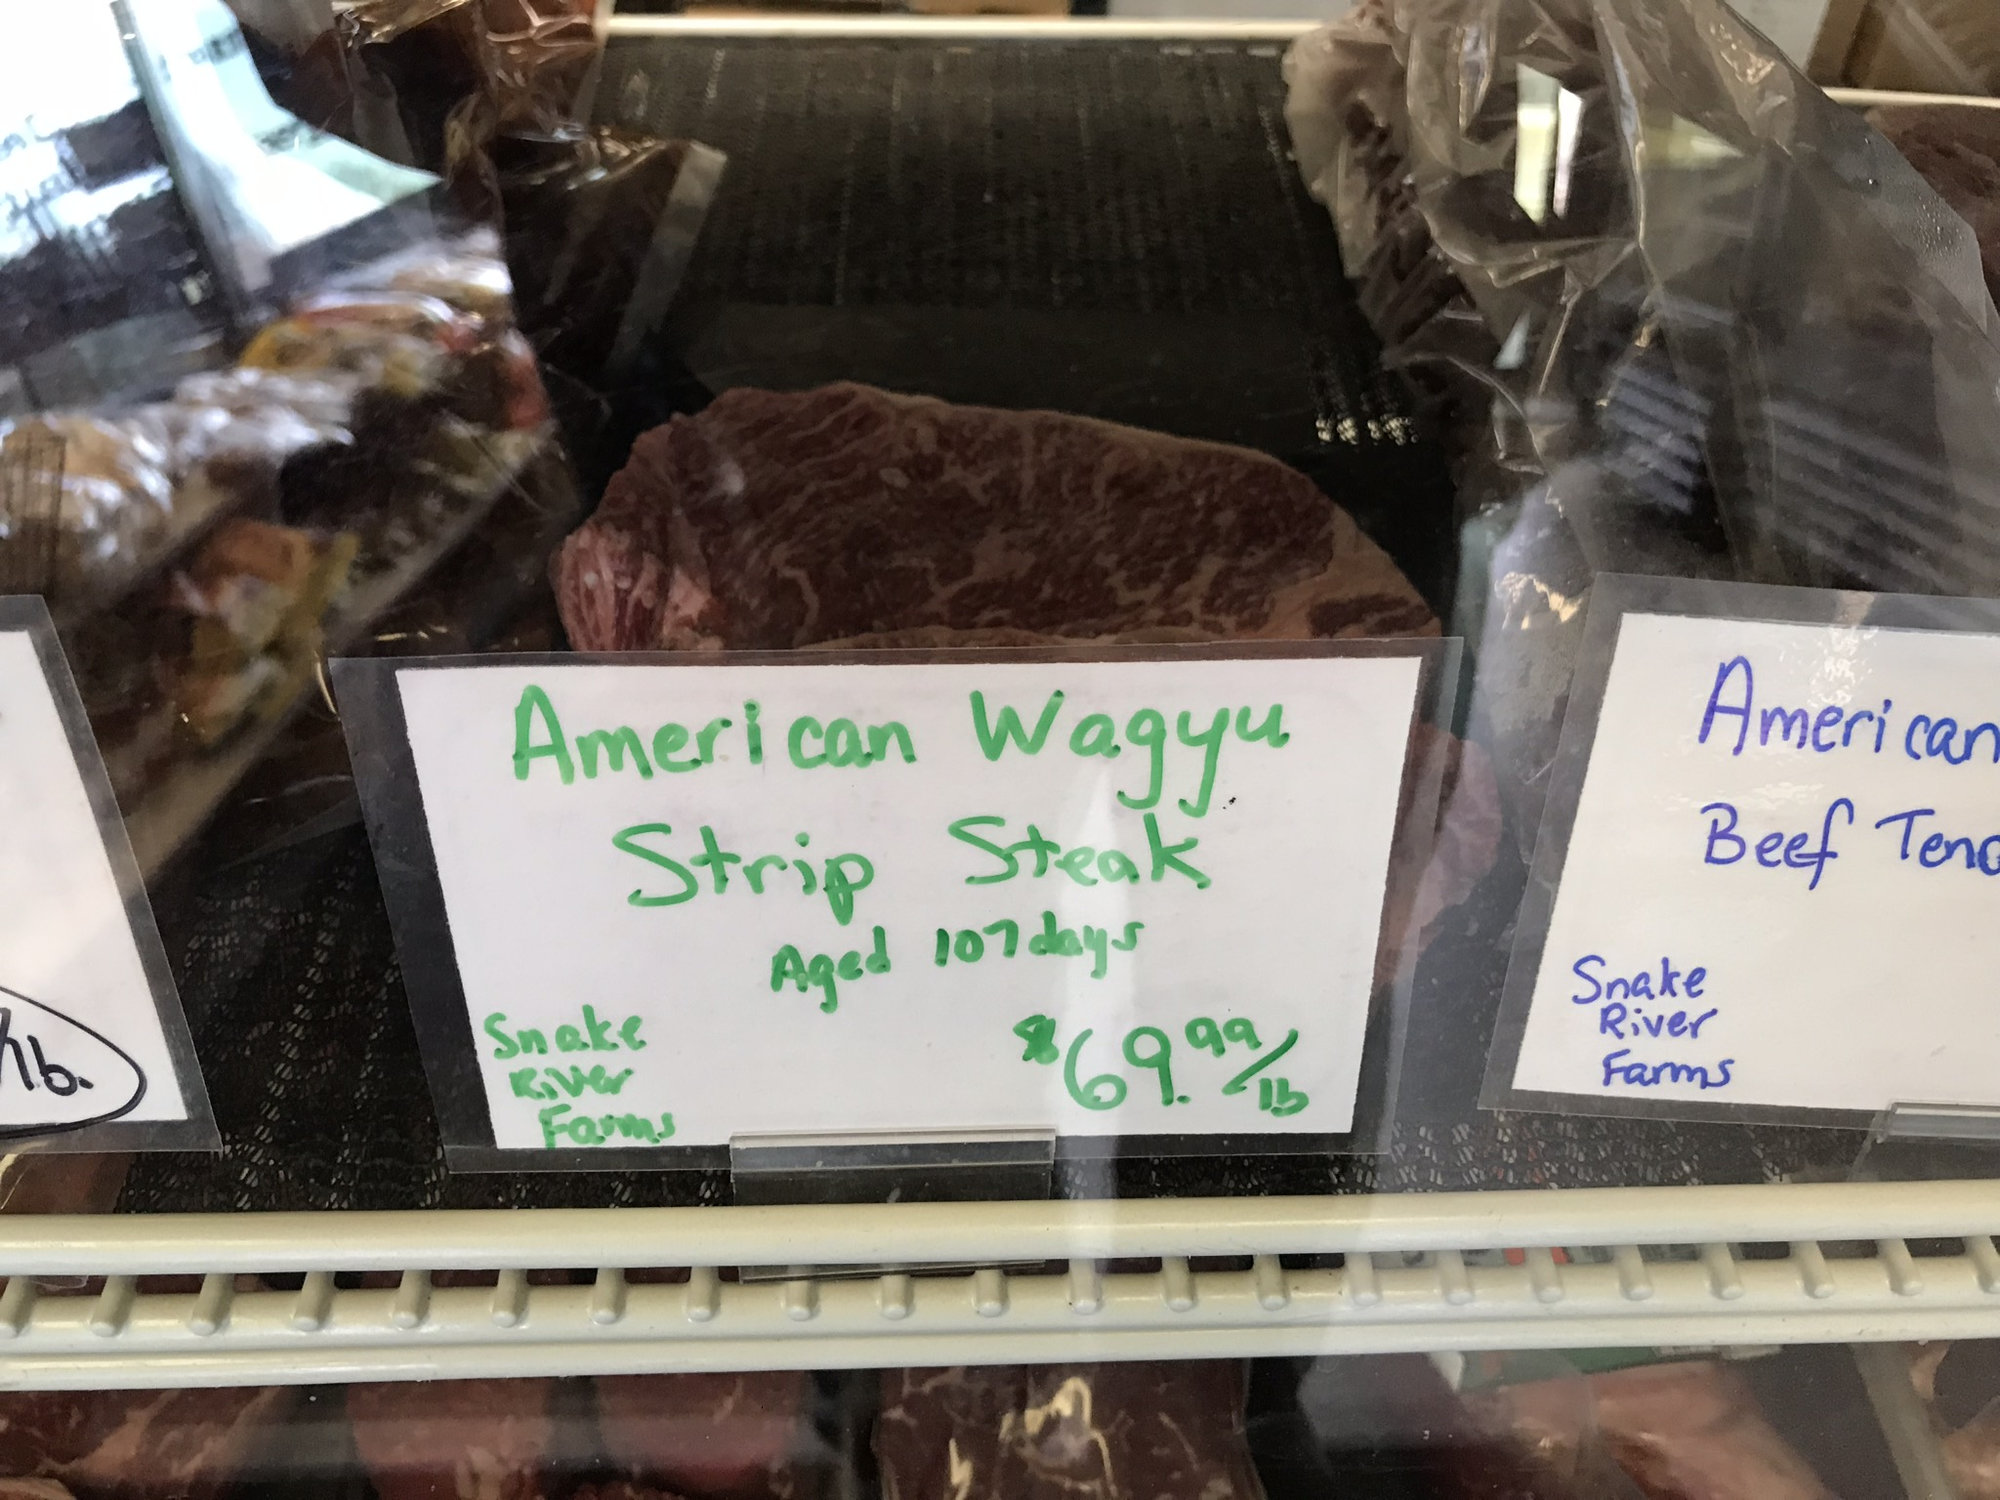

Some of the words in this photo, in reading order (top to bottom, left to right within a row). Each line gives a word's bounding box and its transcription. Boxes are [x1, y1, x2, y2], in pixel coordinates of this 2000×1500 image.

[1698, 655, 2000, 766] American
[512, 685, 917, 784] American
[970, 689, 1291, 817] Wagyu
[613, 823, 875, 924] Strip
[948, 813, 1211, 889] Steak
[1699, 797, 1855, 891] Beef
[769, 926, 892, 1012] Aged
[1571, 954, 1708, 1005] Snake
[484, 1004, 647, 1059] Snake
[1599, 1003, 1719, 1040] River
[508, 1065, 634, 1100] River
[1602, 1048, 1736, 1090] Farms
[538, 1103, 676, 1150] Farms
